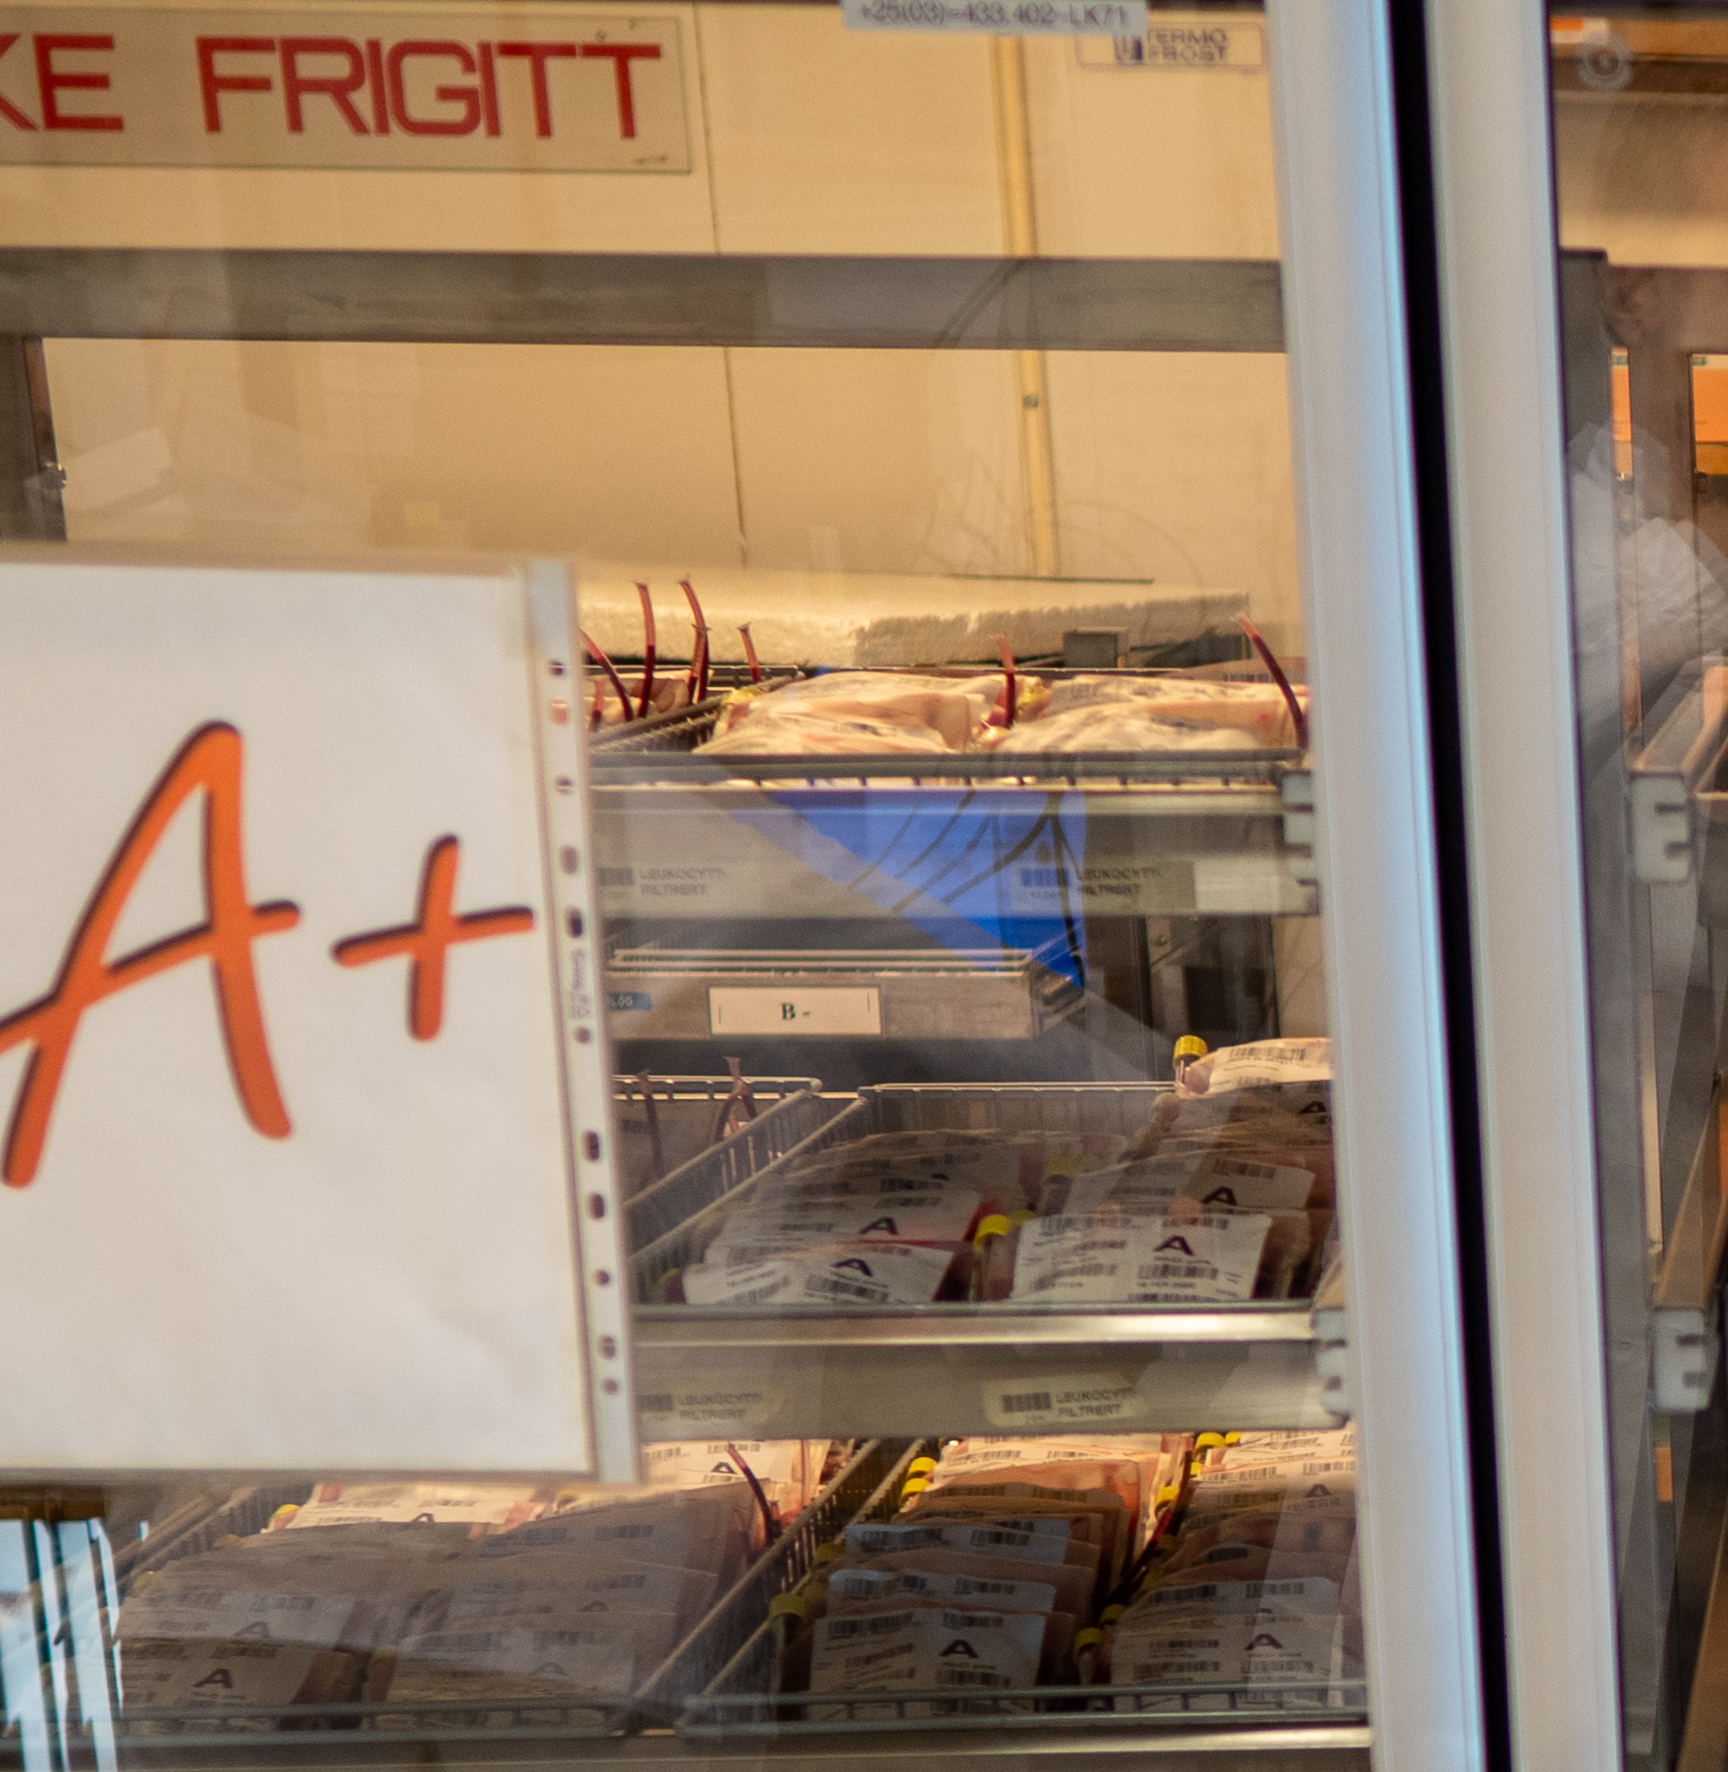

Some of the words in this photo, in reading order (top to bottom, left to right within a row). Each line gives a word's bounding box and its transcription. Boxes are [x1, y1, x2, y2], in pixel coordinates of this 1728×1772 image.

[195, 35, 661, 140] FRIGITT
[0, 720, 535, 1189] A+
[782, 1002, 797, 1020] B
[1201, 1186, 1237, 1206] A
[860, 1216, 898, 1235] A
[1155, 1235, 1194, 1256] A
[834, 1258, 873, 1277] A
[711, 1461, 737, 1475] A
[940, 1639, 979, 1659] A
[1243, 1633, 1283, 1652] A
[194, 1667, 233, 1689] A
